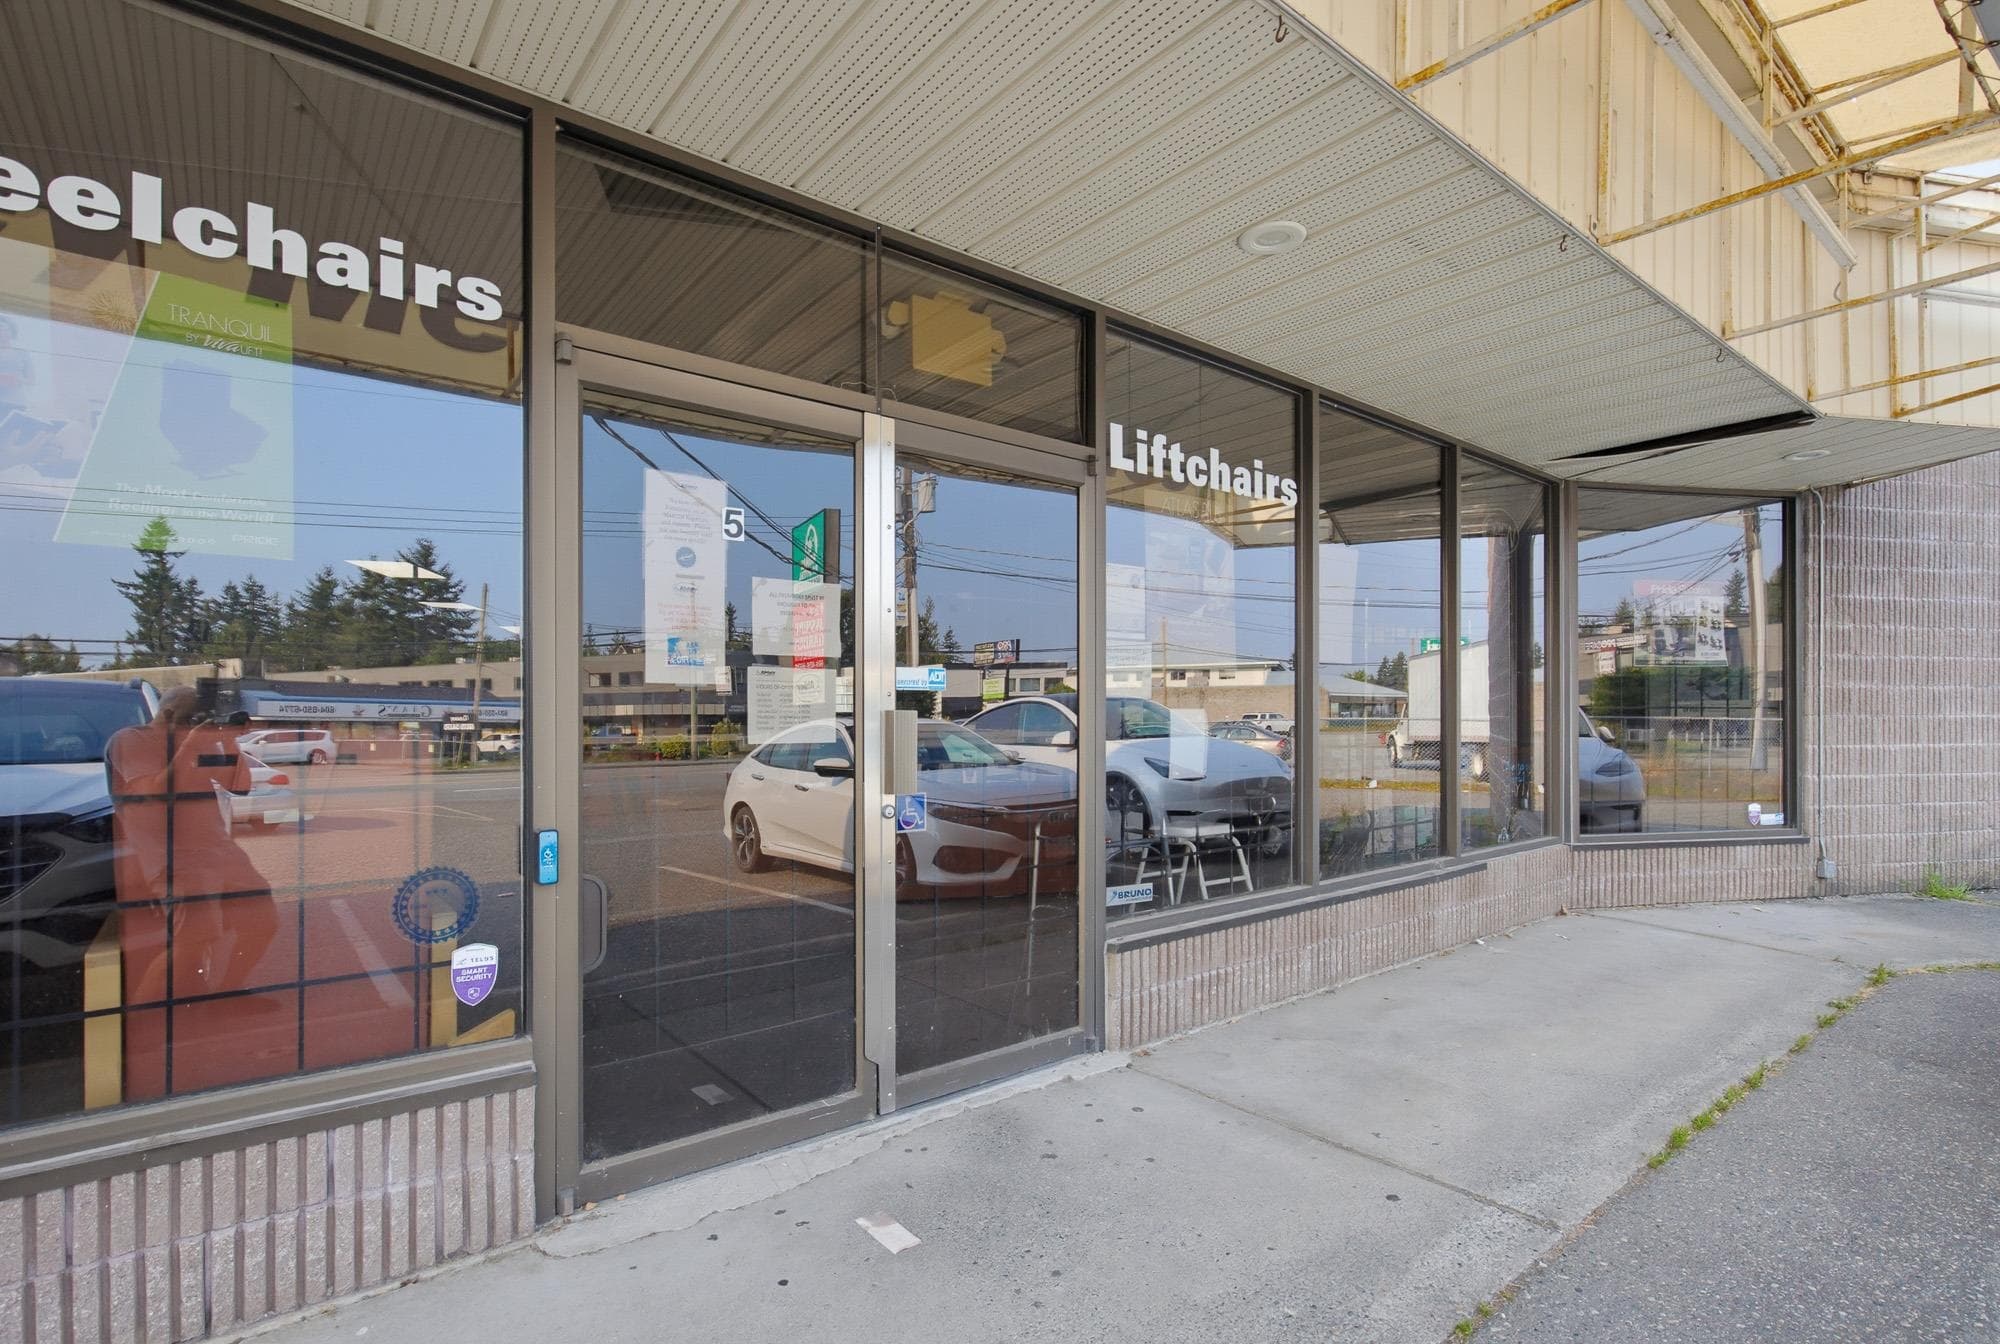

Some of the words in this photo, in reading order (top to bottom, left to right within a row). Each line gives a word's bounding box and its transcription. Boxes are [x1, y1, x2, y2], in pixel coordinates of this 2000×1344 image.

[167, 303, 273, 342] TRANQUIL
[1109, 422, 1298, 506] Liftchairs
[724, 509, 744, 539] 5
[1117, 888, 1152, 899] BRUNO
[456, 973, 492, 983] SECURITY
[461, 967, 487, 976] SMART
